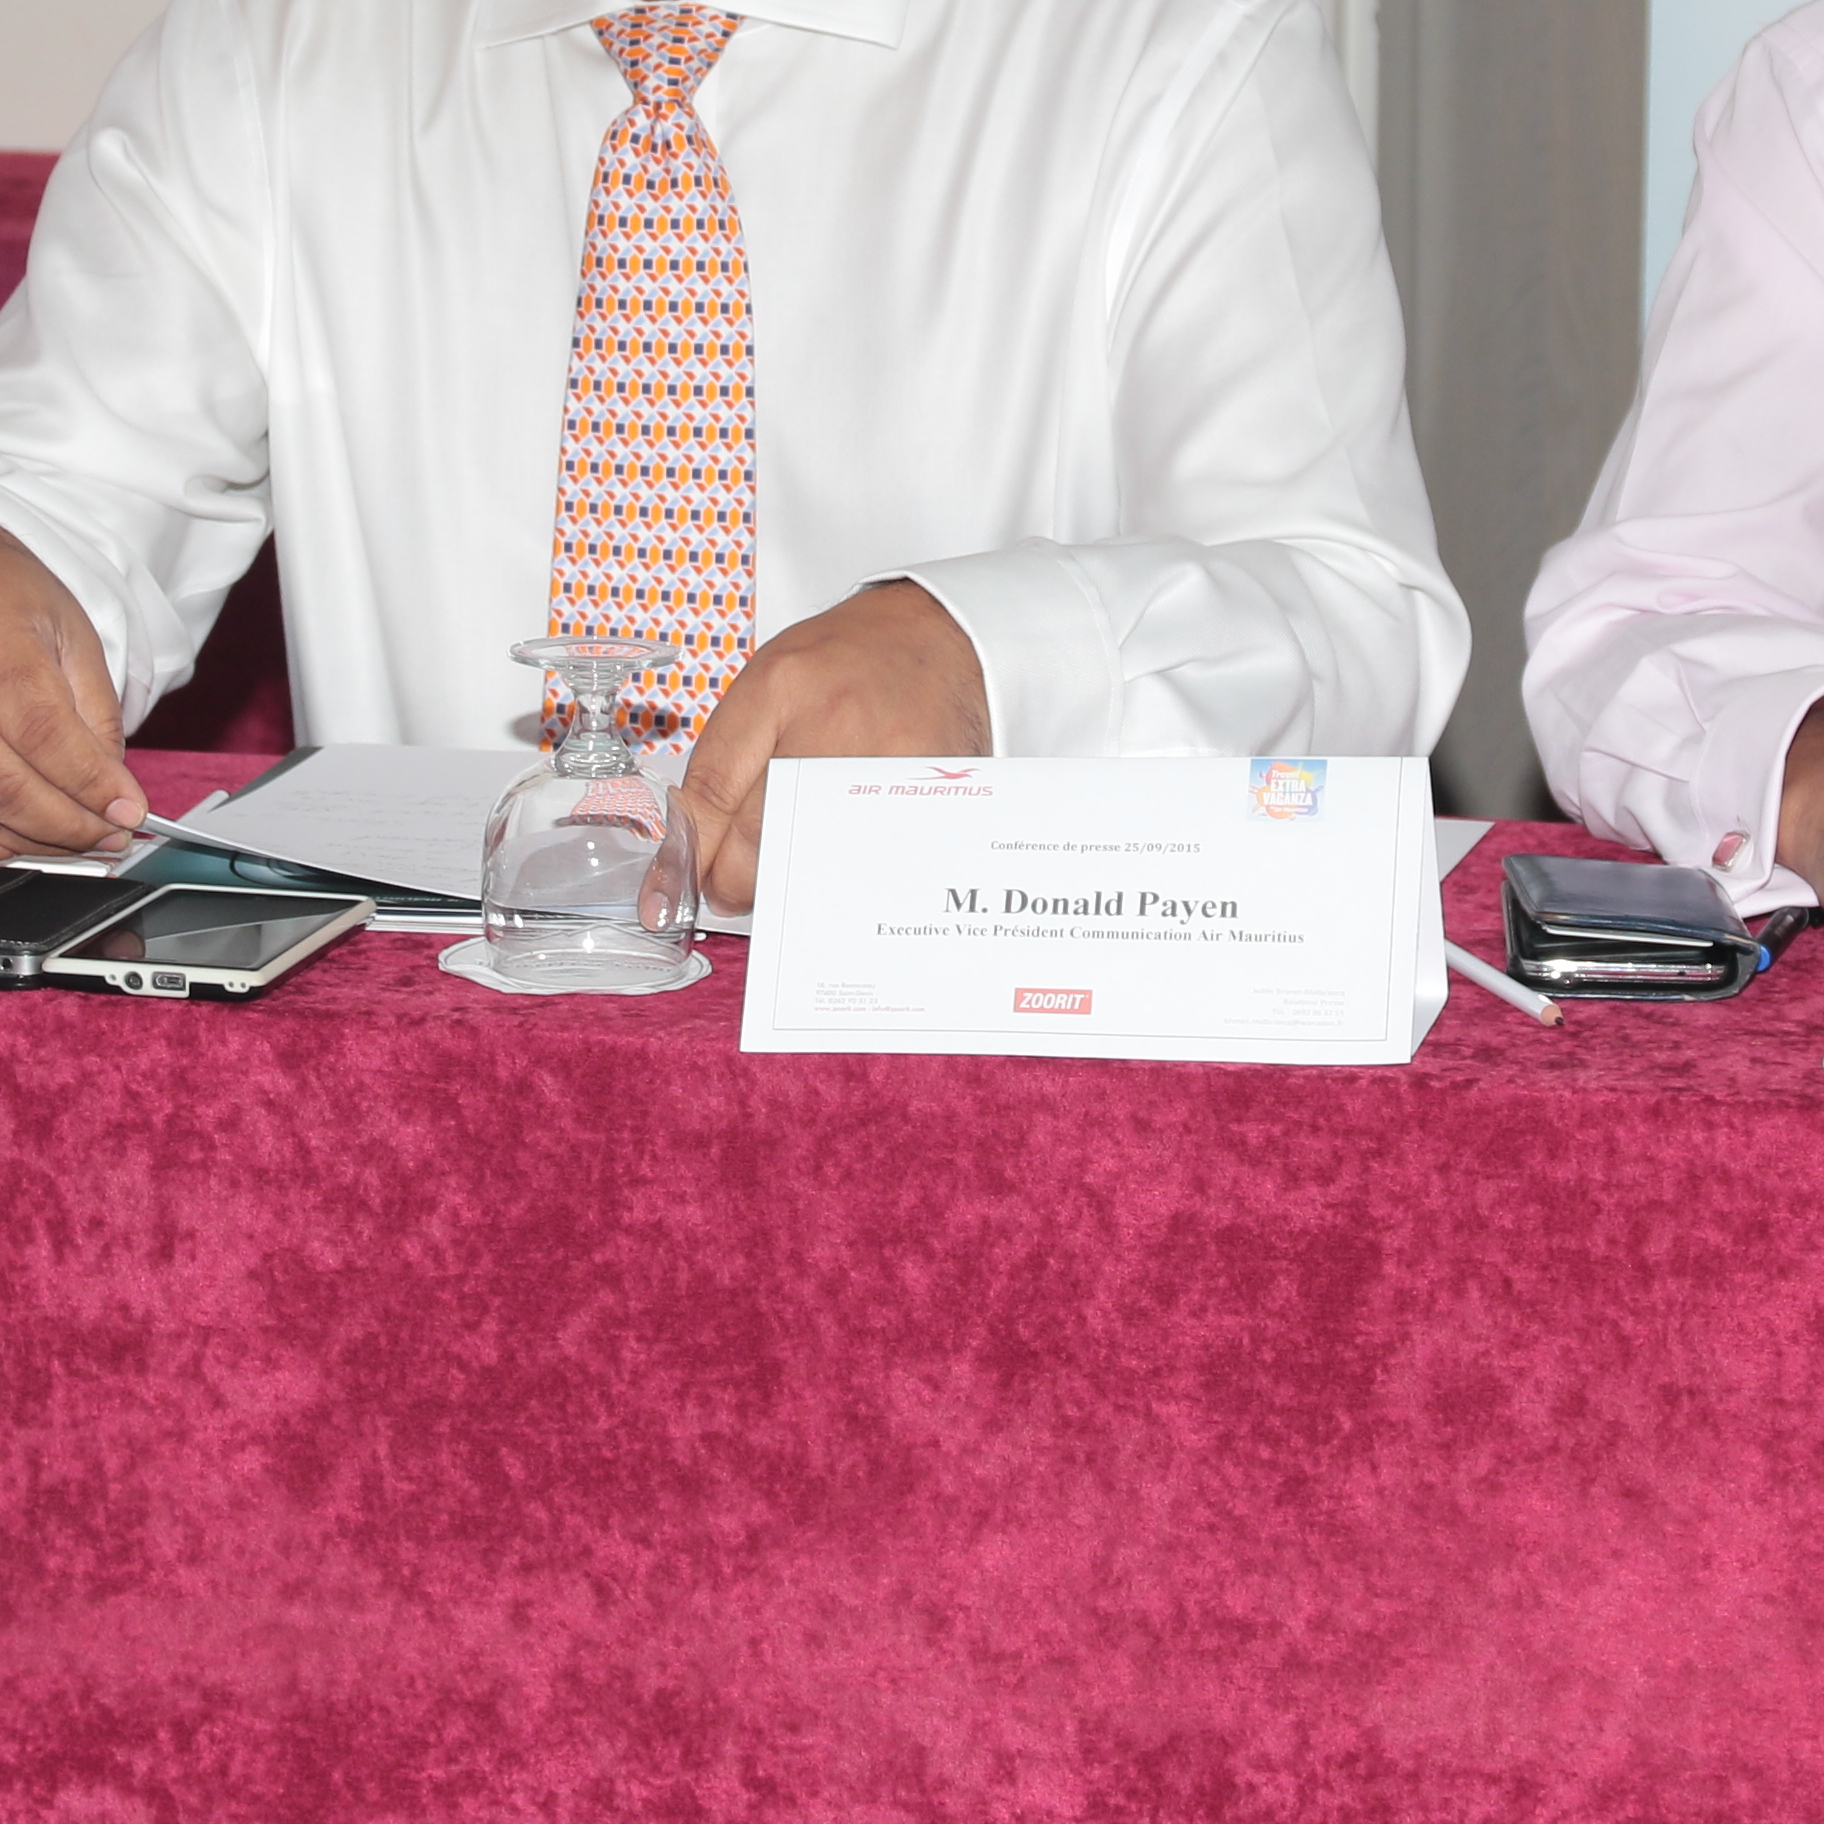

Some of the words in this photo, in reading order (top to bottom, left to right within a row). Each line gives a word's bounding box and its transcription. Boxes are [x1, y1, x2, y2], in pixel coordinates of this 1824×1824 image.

[990, 840, 1060, 851] Conférence
[1062, 841, 1078, 851] de
[1080, 843, 1121, 854] presse
[1124, 842, 1201, 855] 25/09/2015
[944, 888, 988, 914] M.
[1003, 888, 1124, 917] Donald
[1138, 891, 1239, 926] Payen
[876, 923, 950, 936] Executive
[955, 924, 988, 937] Vice
[993, 924, 1064, 939] Président
[1069, 927, 1192, 941] Communication
[1198, 929, 1223, 942] Air
[1229, 929, 1305, 944] Mauritius
[1019, 992, 1085, 1010] ZOORIT
